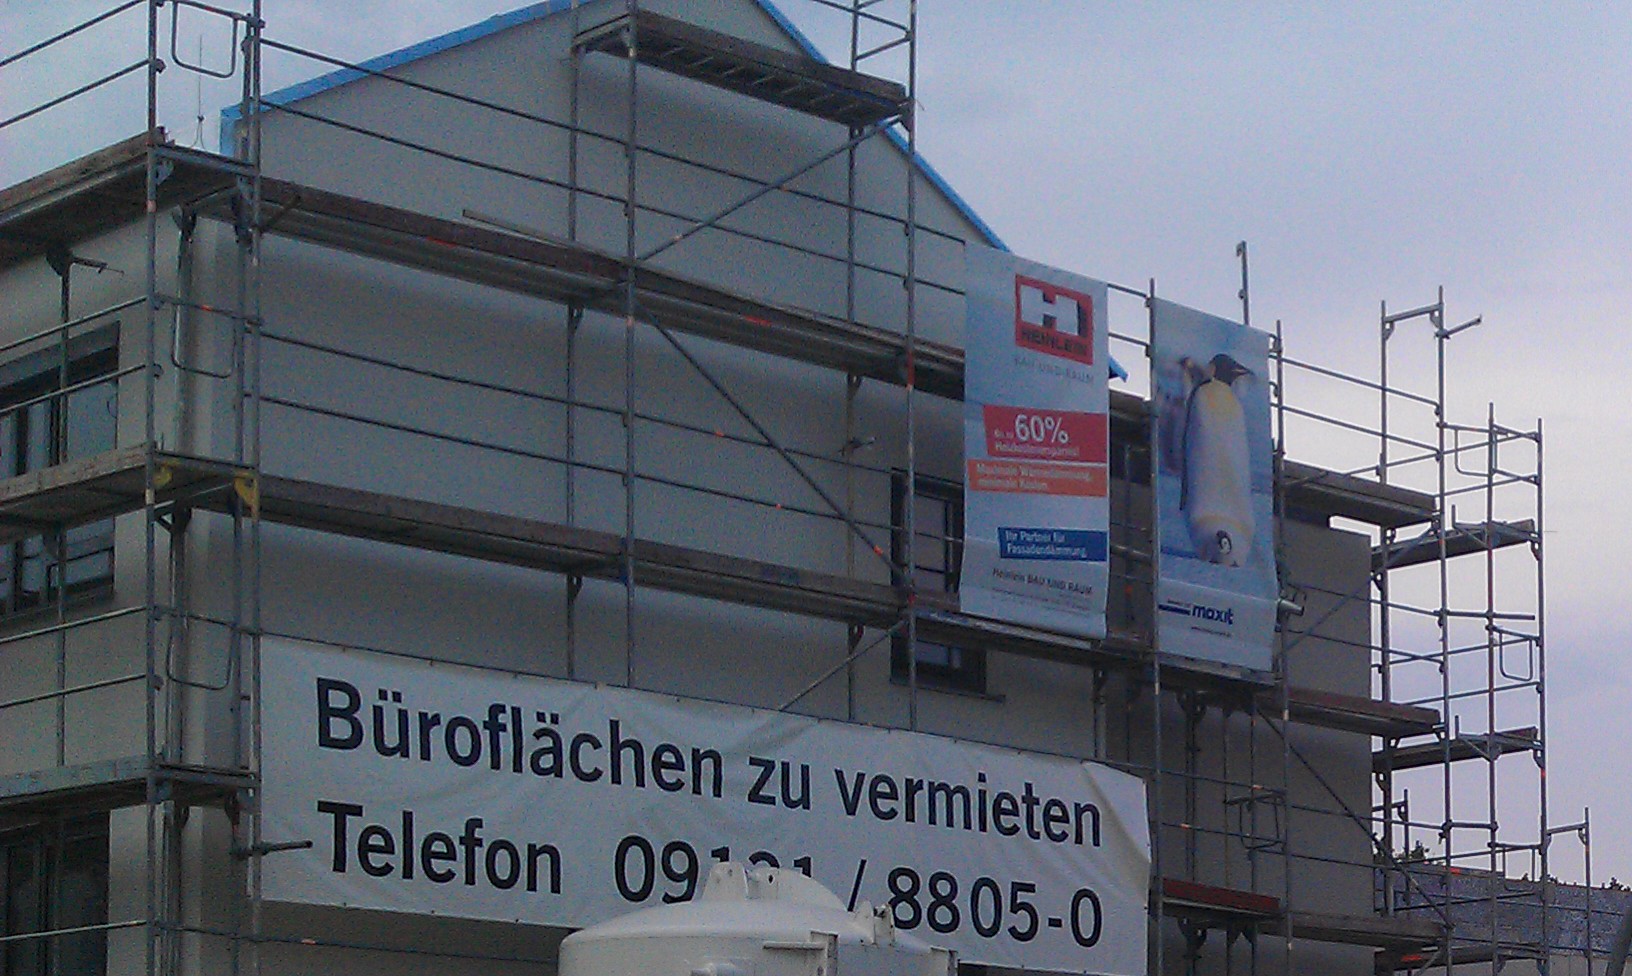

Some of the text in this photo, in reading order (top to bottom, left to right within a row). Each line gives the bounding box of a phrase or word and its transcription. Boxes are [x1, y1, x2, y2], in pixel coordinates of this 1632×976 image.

[1015, 413, 1069, 444] 60%
[1192, 604, 1234, 625] maxit
[316, 676, 1102, 848] Büroflächen zu vermieten
[316, 800, 563, 895] Telefon
[887, 866, 1103, 949] 8805-0
